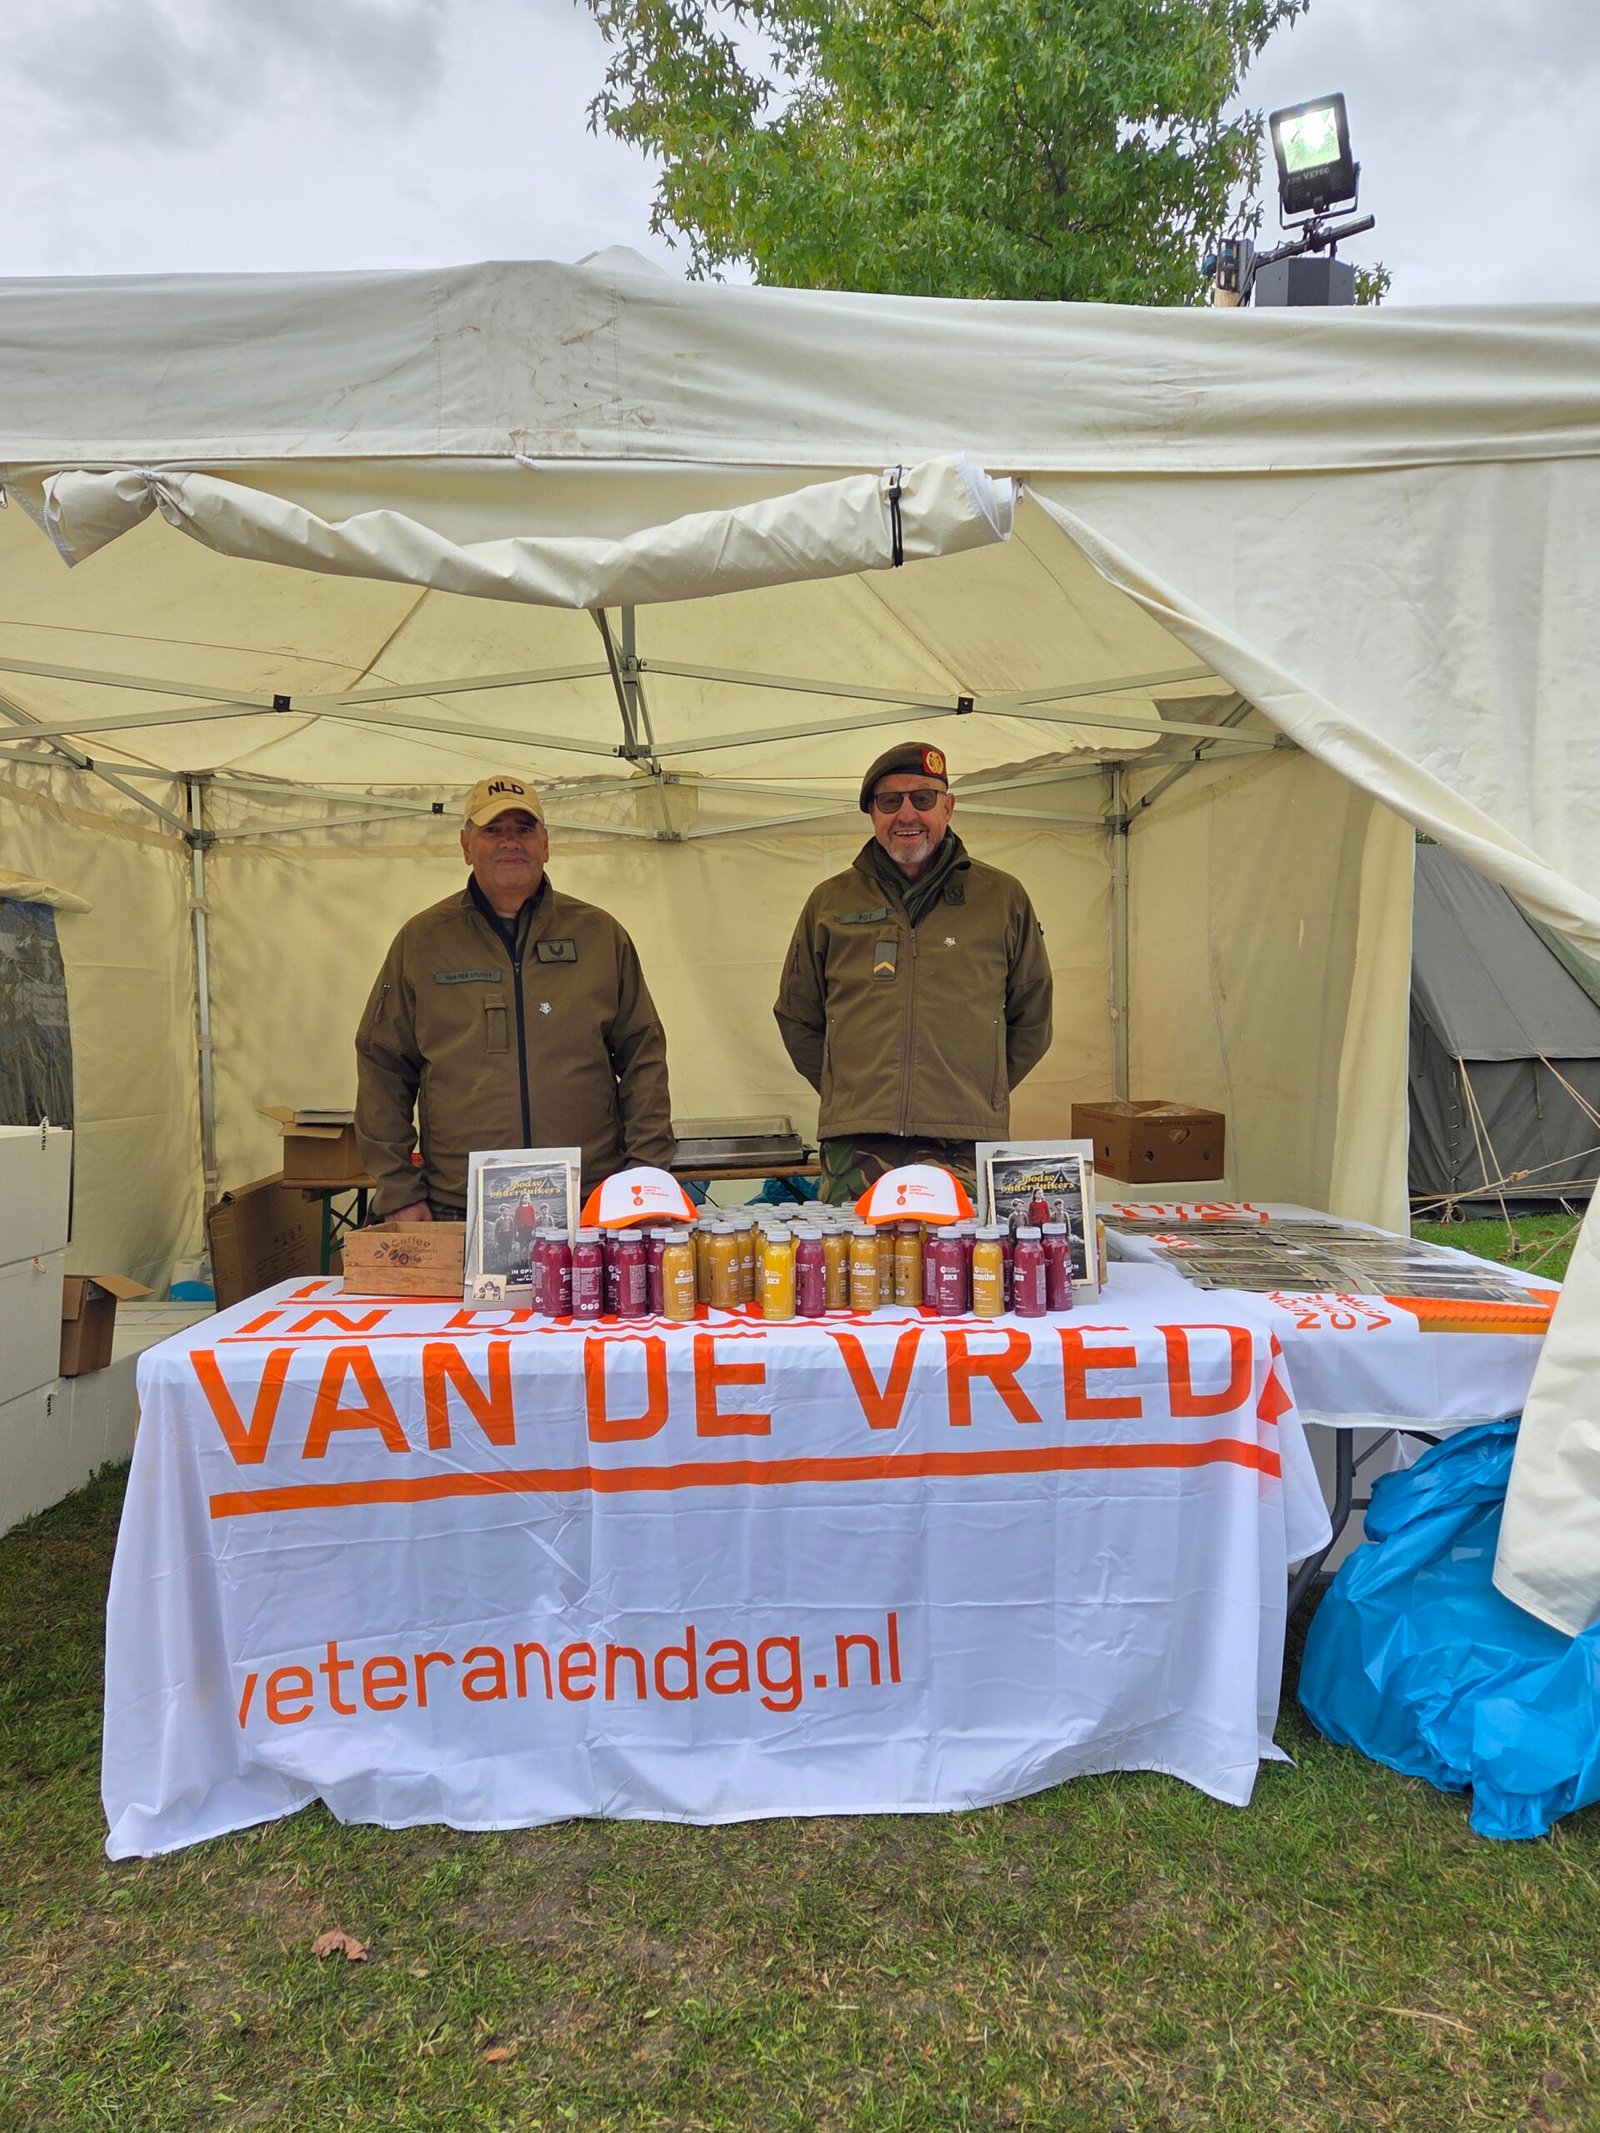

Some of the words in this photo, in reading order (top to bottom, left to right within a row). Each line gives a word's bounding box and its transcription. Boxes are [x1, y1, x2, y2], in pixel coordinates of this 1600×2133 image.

[488, 781, 525, 796] NLD
[234, 1309, 393, 1334] IN
[189, 1339, 516, 1466] VAN
[584, 1332, 772, 1443] DE
